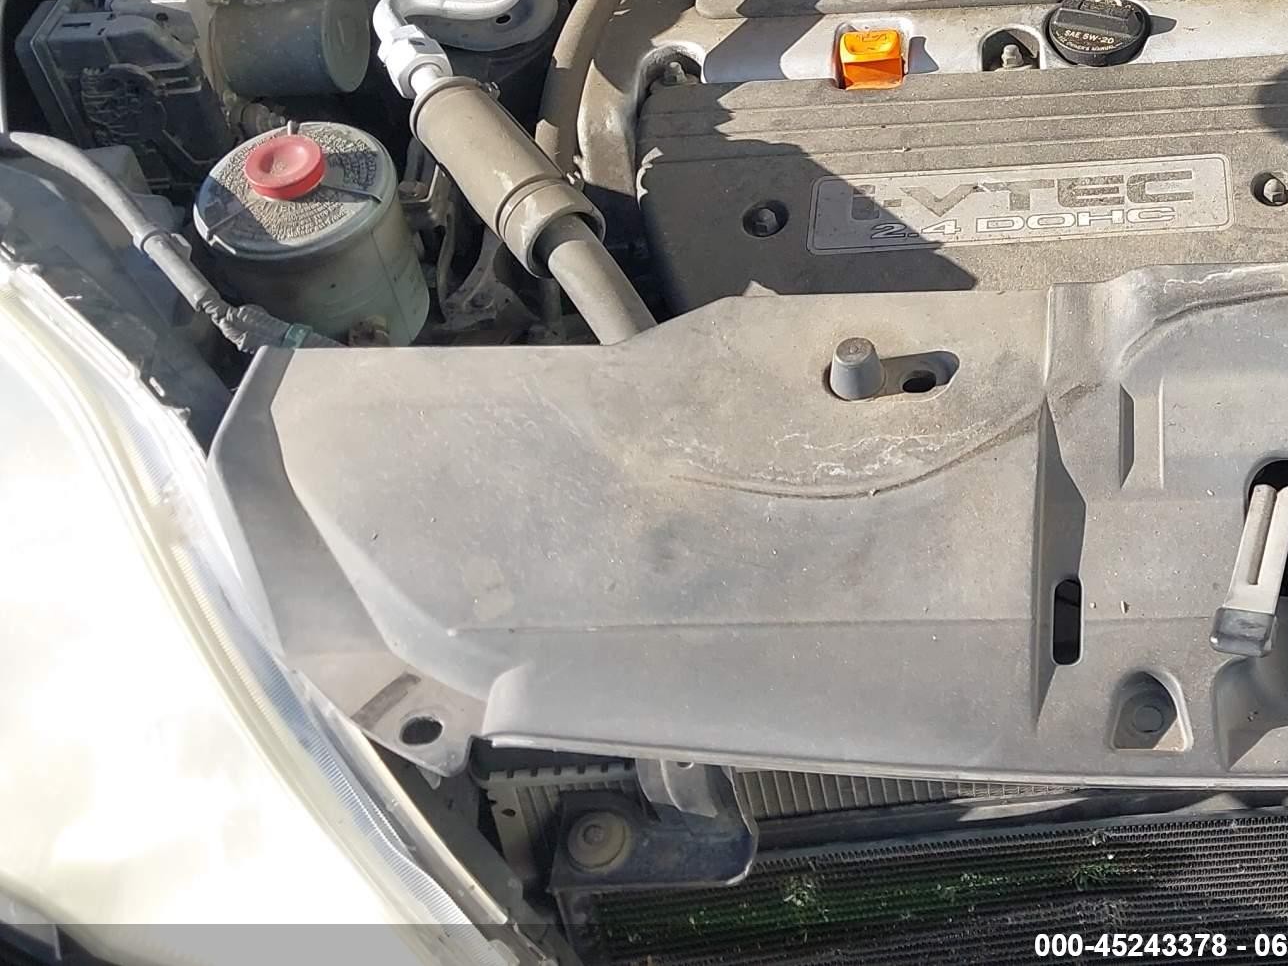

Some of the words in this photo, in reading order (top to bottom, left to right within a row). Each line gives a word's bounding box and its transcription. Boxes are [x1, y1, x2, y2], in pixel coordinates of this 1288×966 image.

[1064, 29, 1080, 40] SAE
[1082, 33, 1115, 45] 5W-20
[870, 218, 961, 240] 2.4
[975, 206, 1176, 233] DOHC
